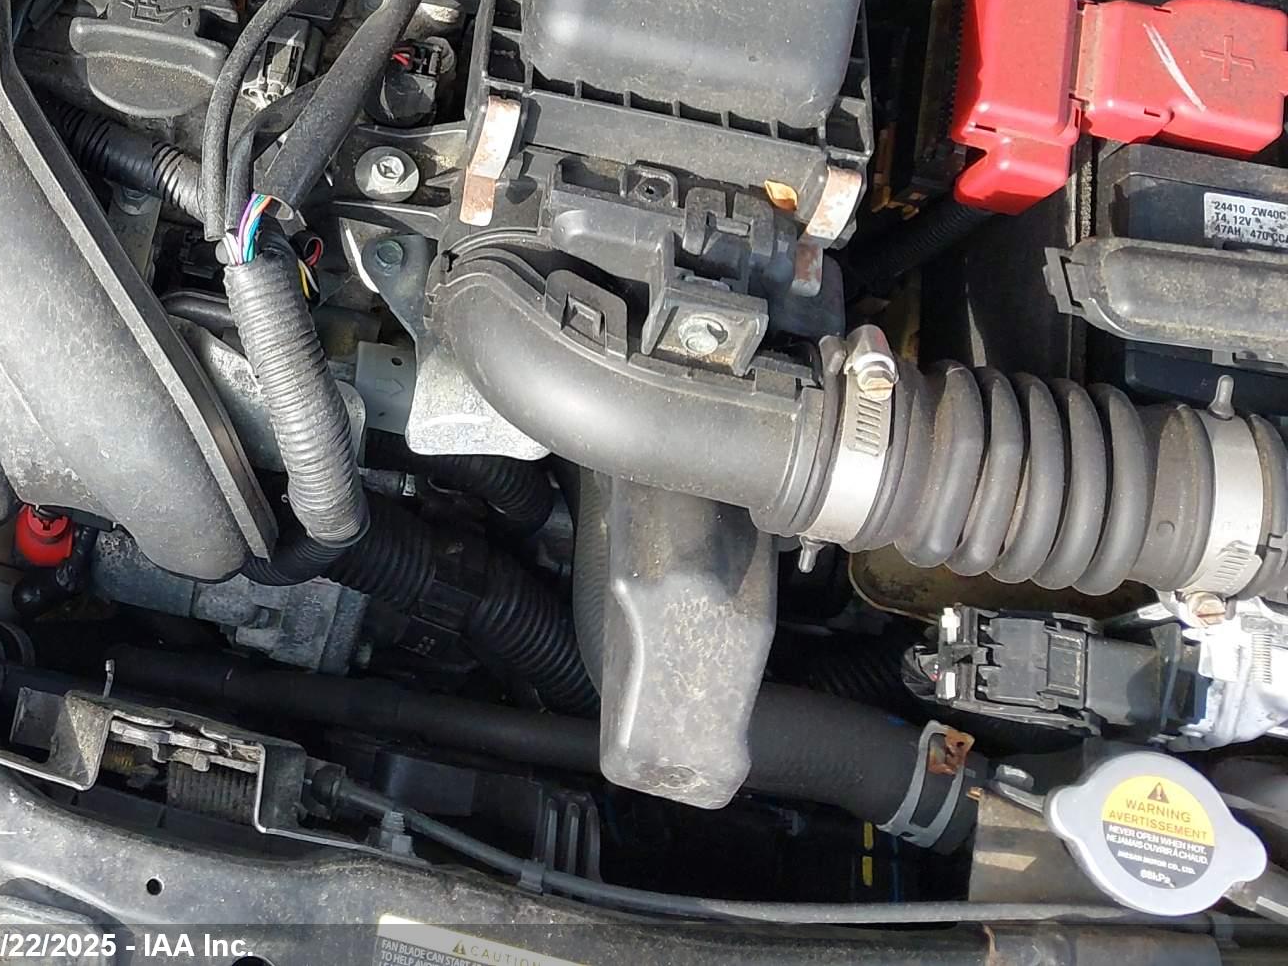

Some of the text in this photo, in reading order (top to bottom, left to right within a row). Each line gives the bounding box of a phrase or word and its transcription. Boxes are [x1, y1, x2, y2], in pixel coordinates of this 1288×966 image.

[1214, 201, 1246, 214] 24410
[1232, 215, 1252, 227] 12V
[1250, 229, 1269, 241] 470
[1125, 798, 1192, 823] WARNING
[1108, 810, 1208, 841] AVERTISSEMENT
[1106, 833, 1118, 843] NE
[1117, 835, 1143, 849] JAMAIS
[1143, 841, 1172, 857] OUVRIR
[1109, 824, 1207, 855] NEVER OPEN WHEN HOT.
[381, 939, 398, 952] FAN
[399, 943, 426, 960] BLADE
[426, 950, 444, 964] CAN
[381, 950, 393, 961] TO
[393, 953, 414, 966] HELP
